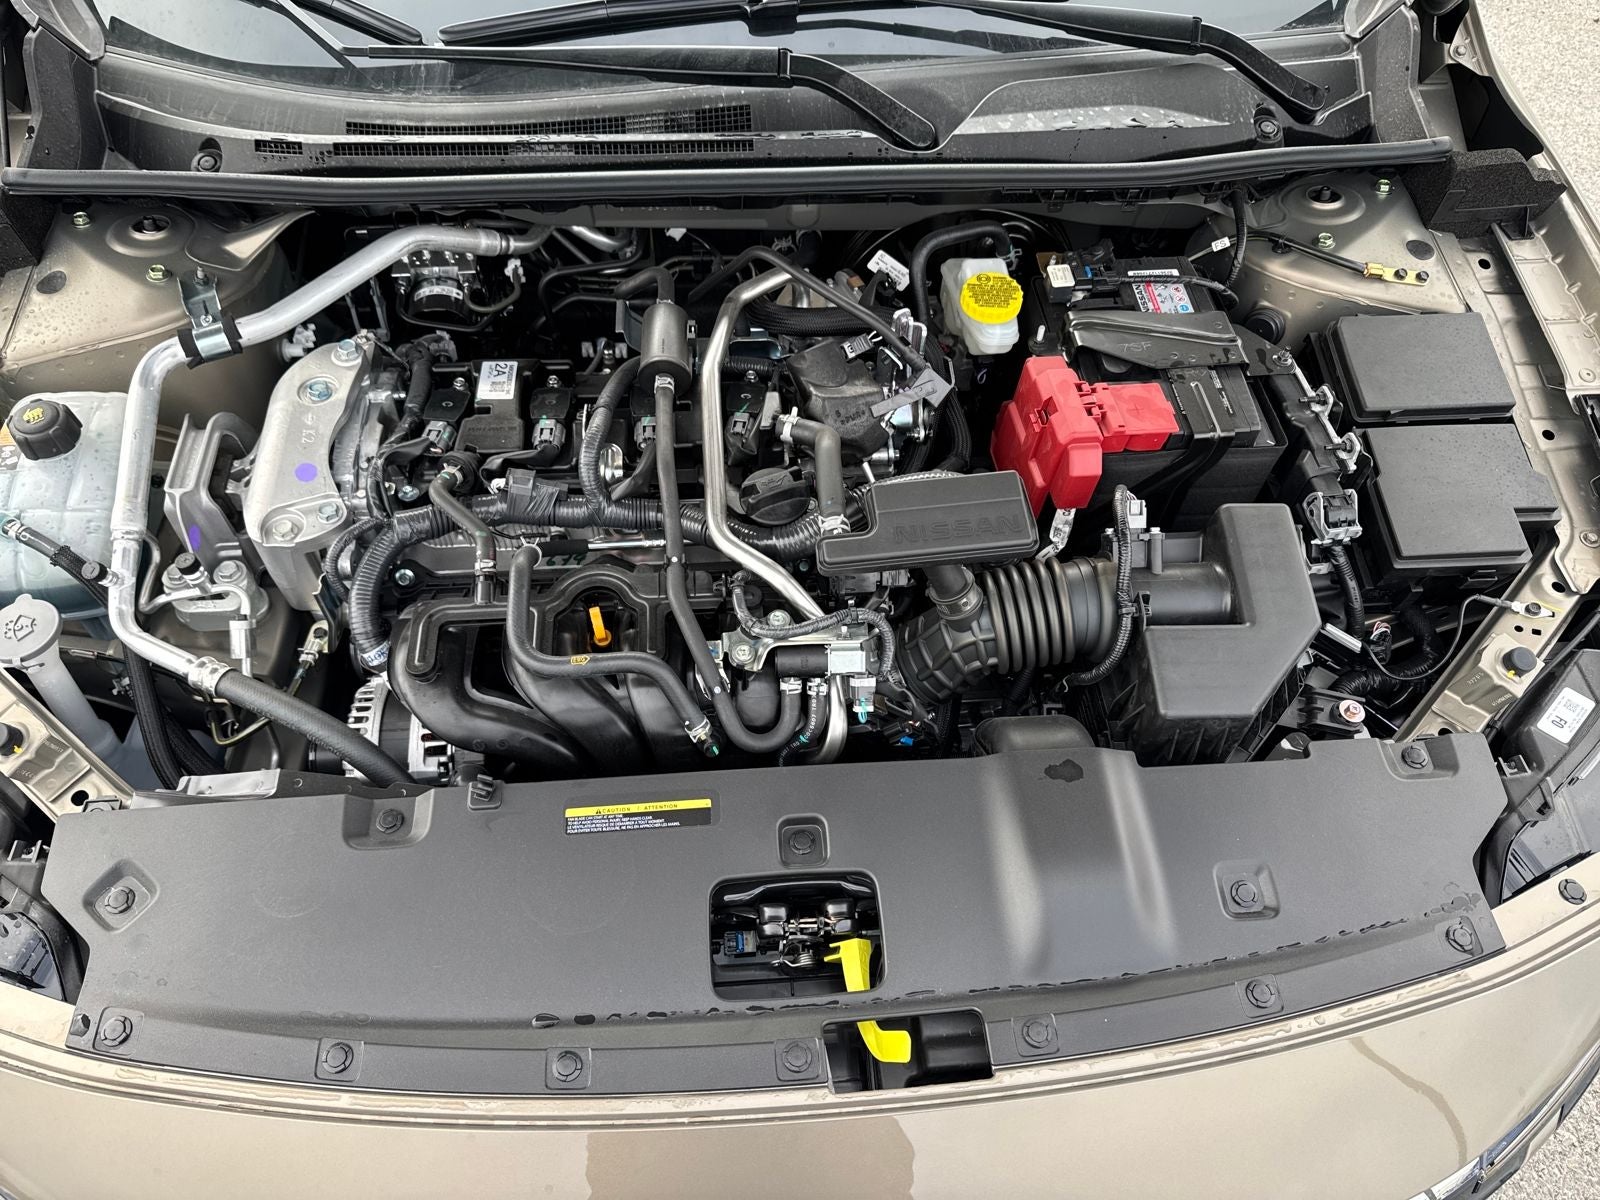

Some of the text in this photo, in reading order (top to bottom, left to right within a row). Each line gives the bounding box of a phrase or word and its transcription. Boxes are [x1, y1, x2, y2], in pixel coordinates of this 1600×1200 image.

[1214, 239, 1227, 250] FS
[493, 363, 508, 378] 2A
[895, 514, 1024, 544] NISSAN
